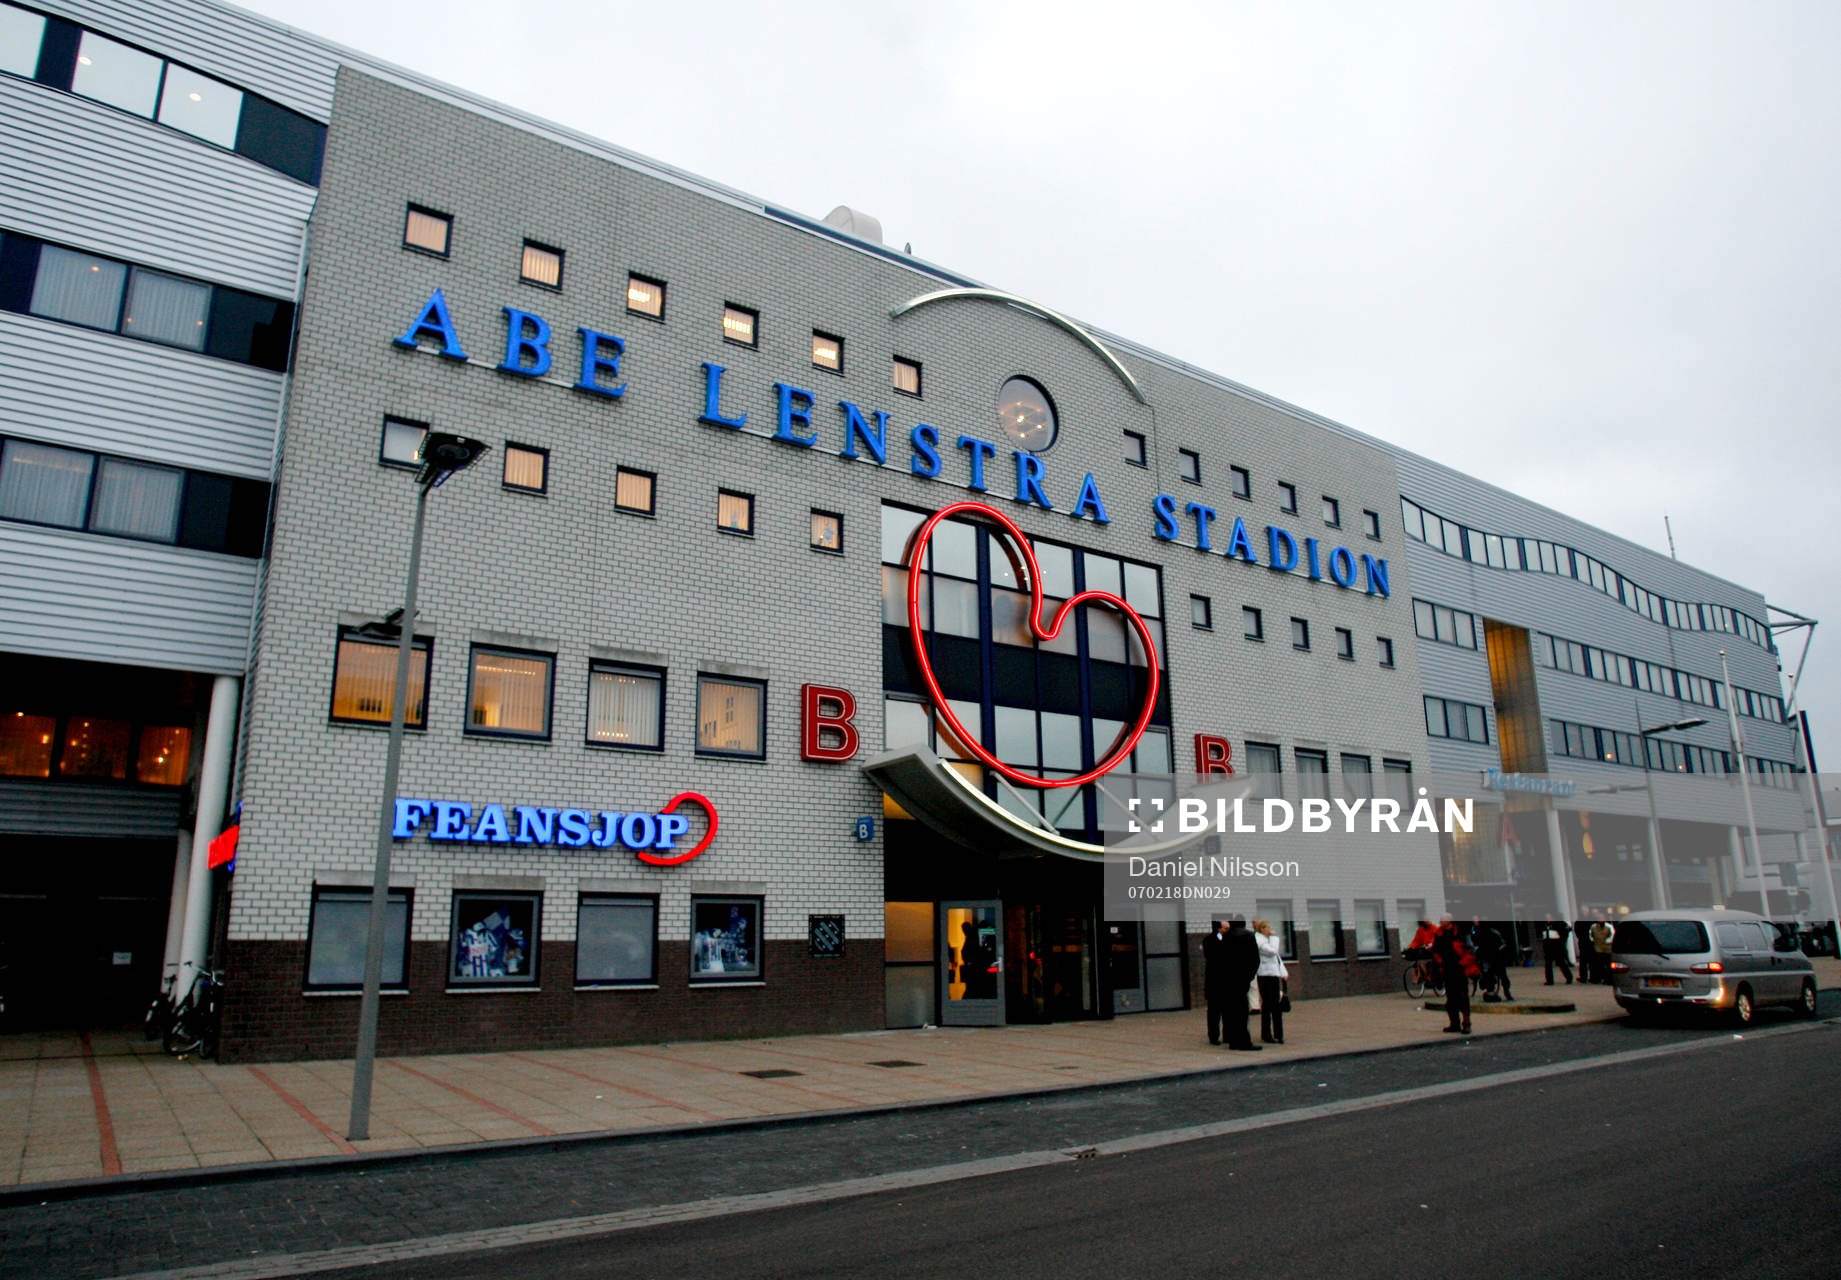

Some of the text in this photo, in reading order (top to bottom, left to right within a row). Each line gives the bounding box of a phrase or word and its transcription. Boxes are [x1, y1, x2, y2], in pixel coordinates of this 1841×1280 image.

[393, 287, 1391, 597] ABE LENSTRA STADION
[801, 683, 859, 763] B
[391, 797, 690, 850] FEANSJOP
[859, 824, 869, 839] B
